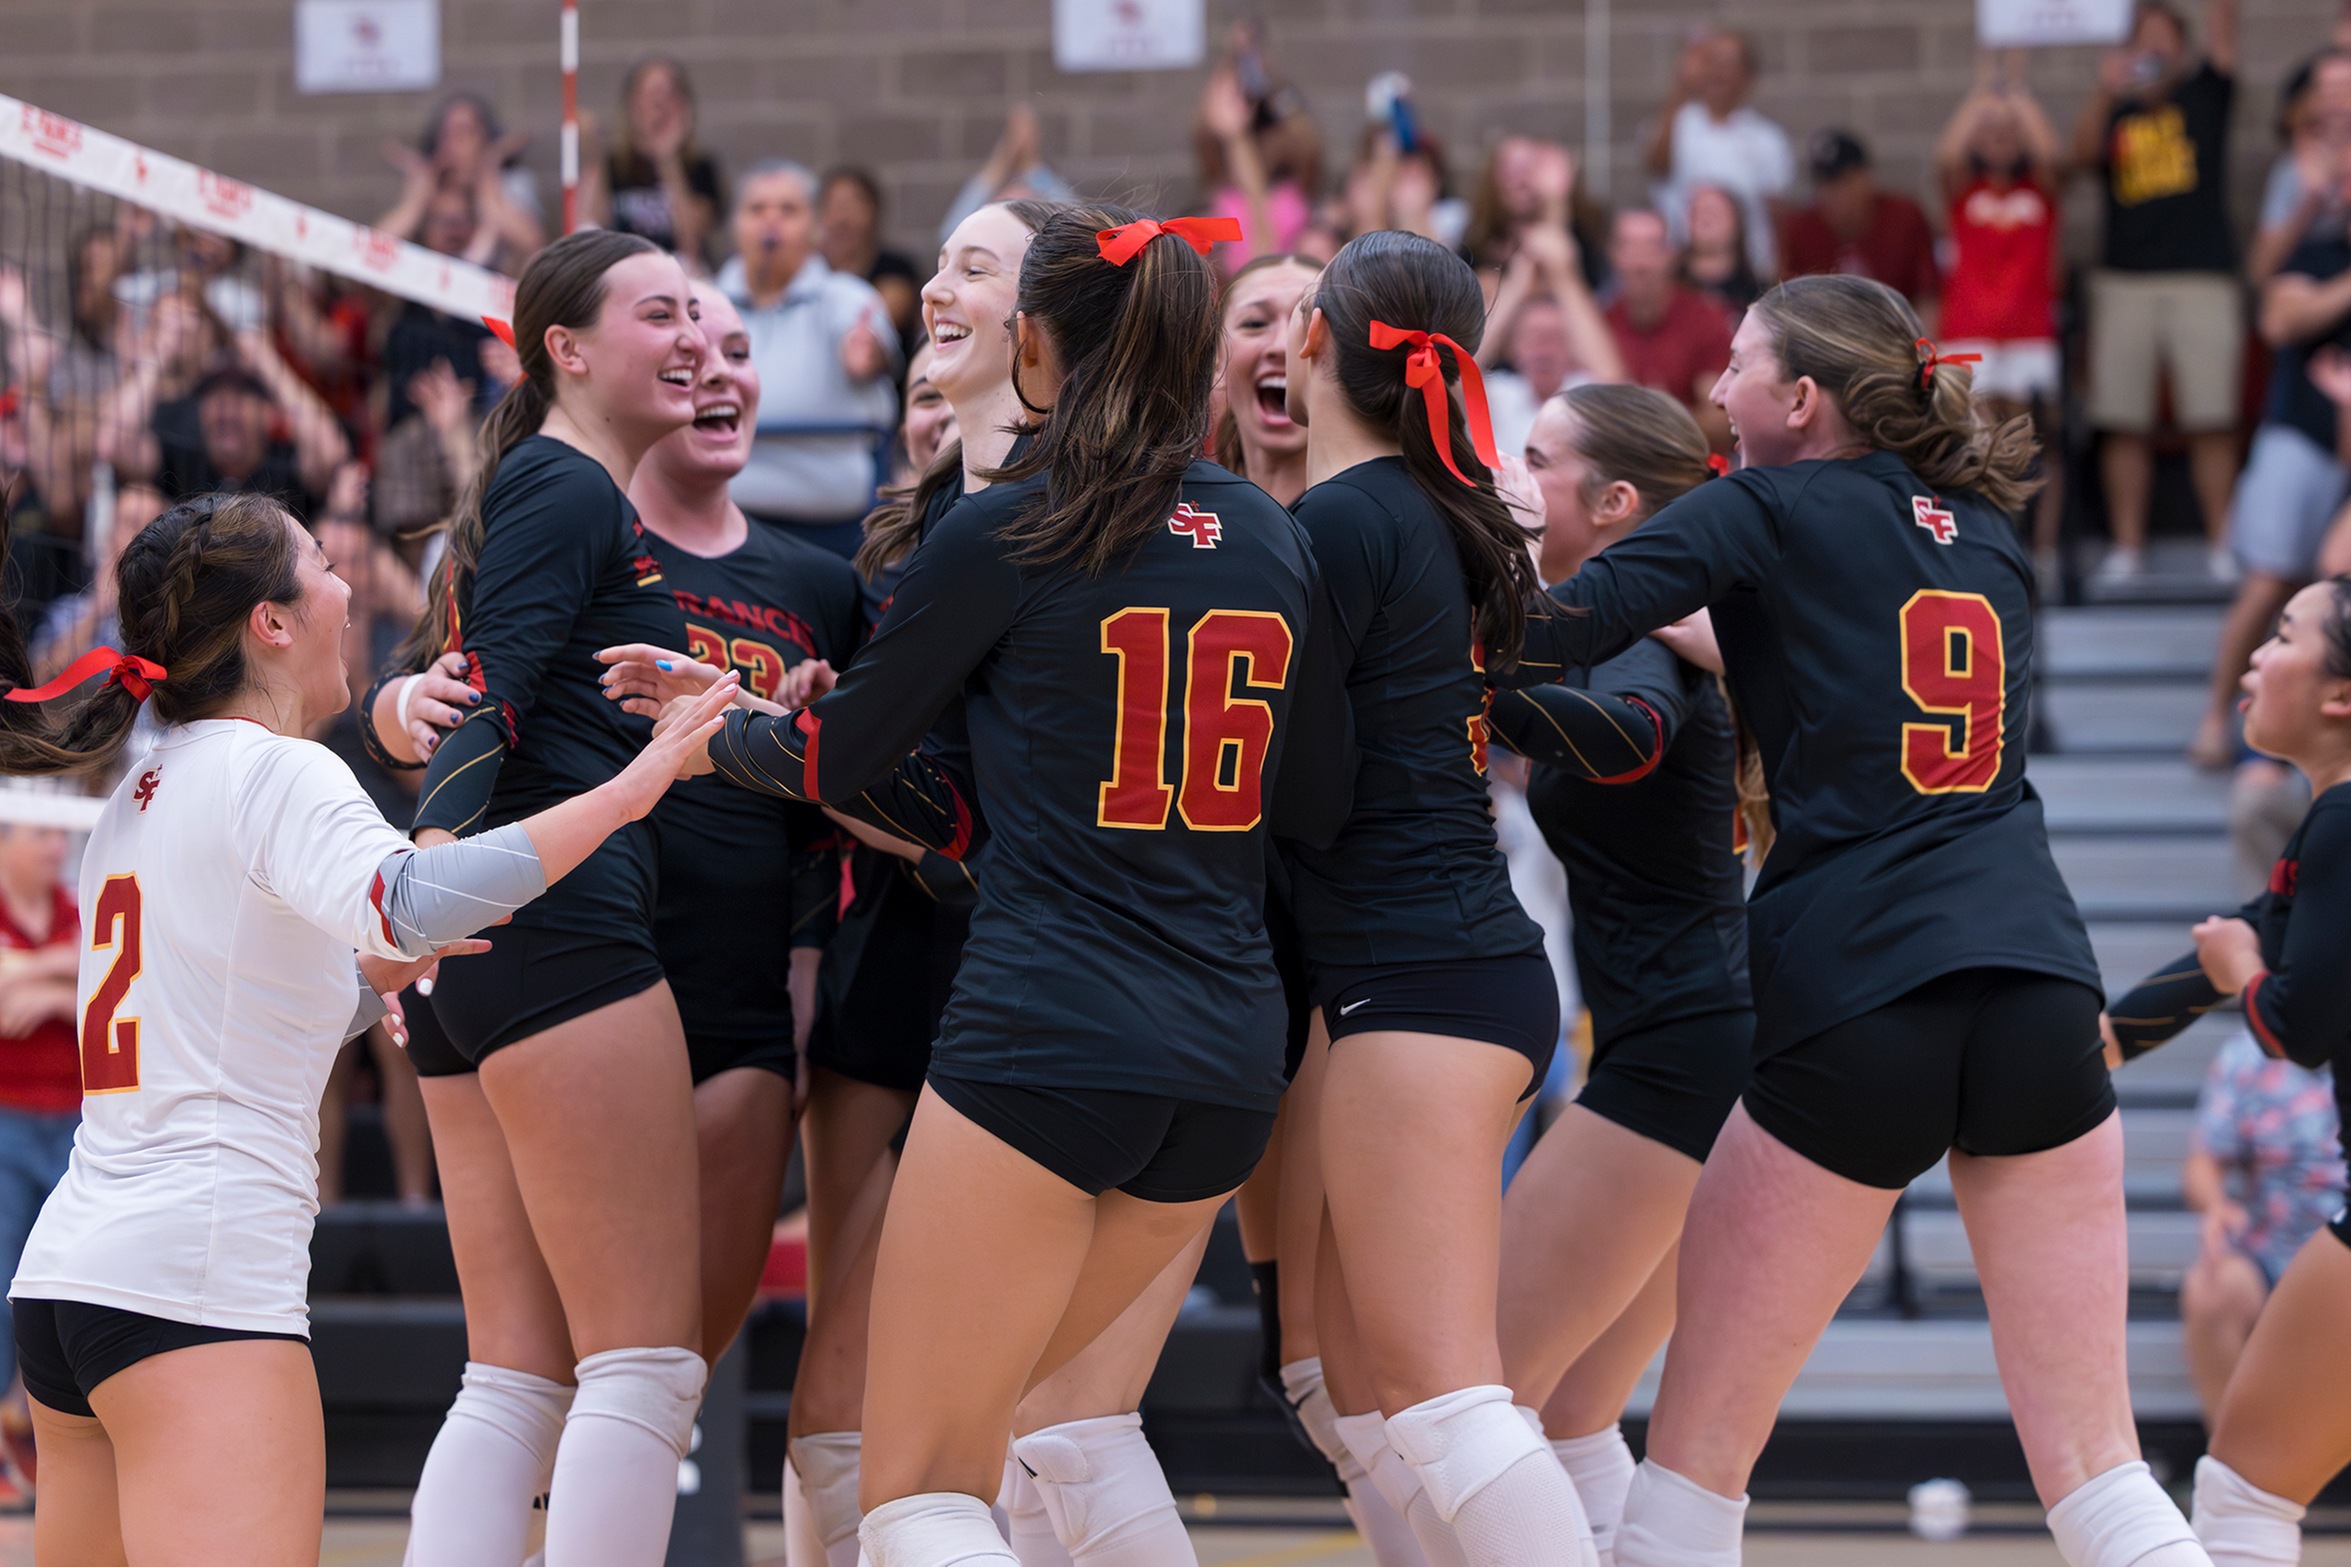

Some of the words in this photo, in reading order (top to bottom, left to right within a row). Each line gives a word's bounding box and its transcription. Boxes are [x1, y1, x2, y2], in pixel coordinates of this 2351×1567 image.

[1167, 503, 1223, 549] SF
[1911, 495, 1959, 545] SF
[685, 622, 787, 701] 23
[1899, 588, 2006, 795] 9
[1097, 606, 1294, 832] 16
[131, 768, 162, 815] SF
[80, 870, 143, 1096] 2
